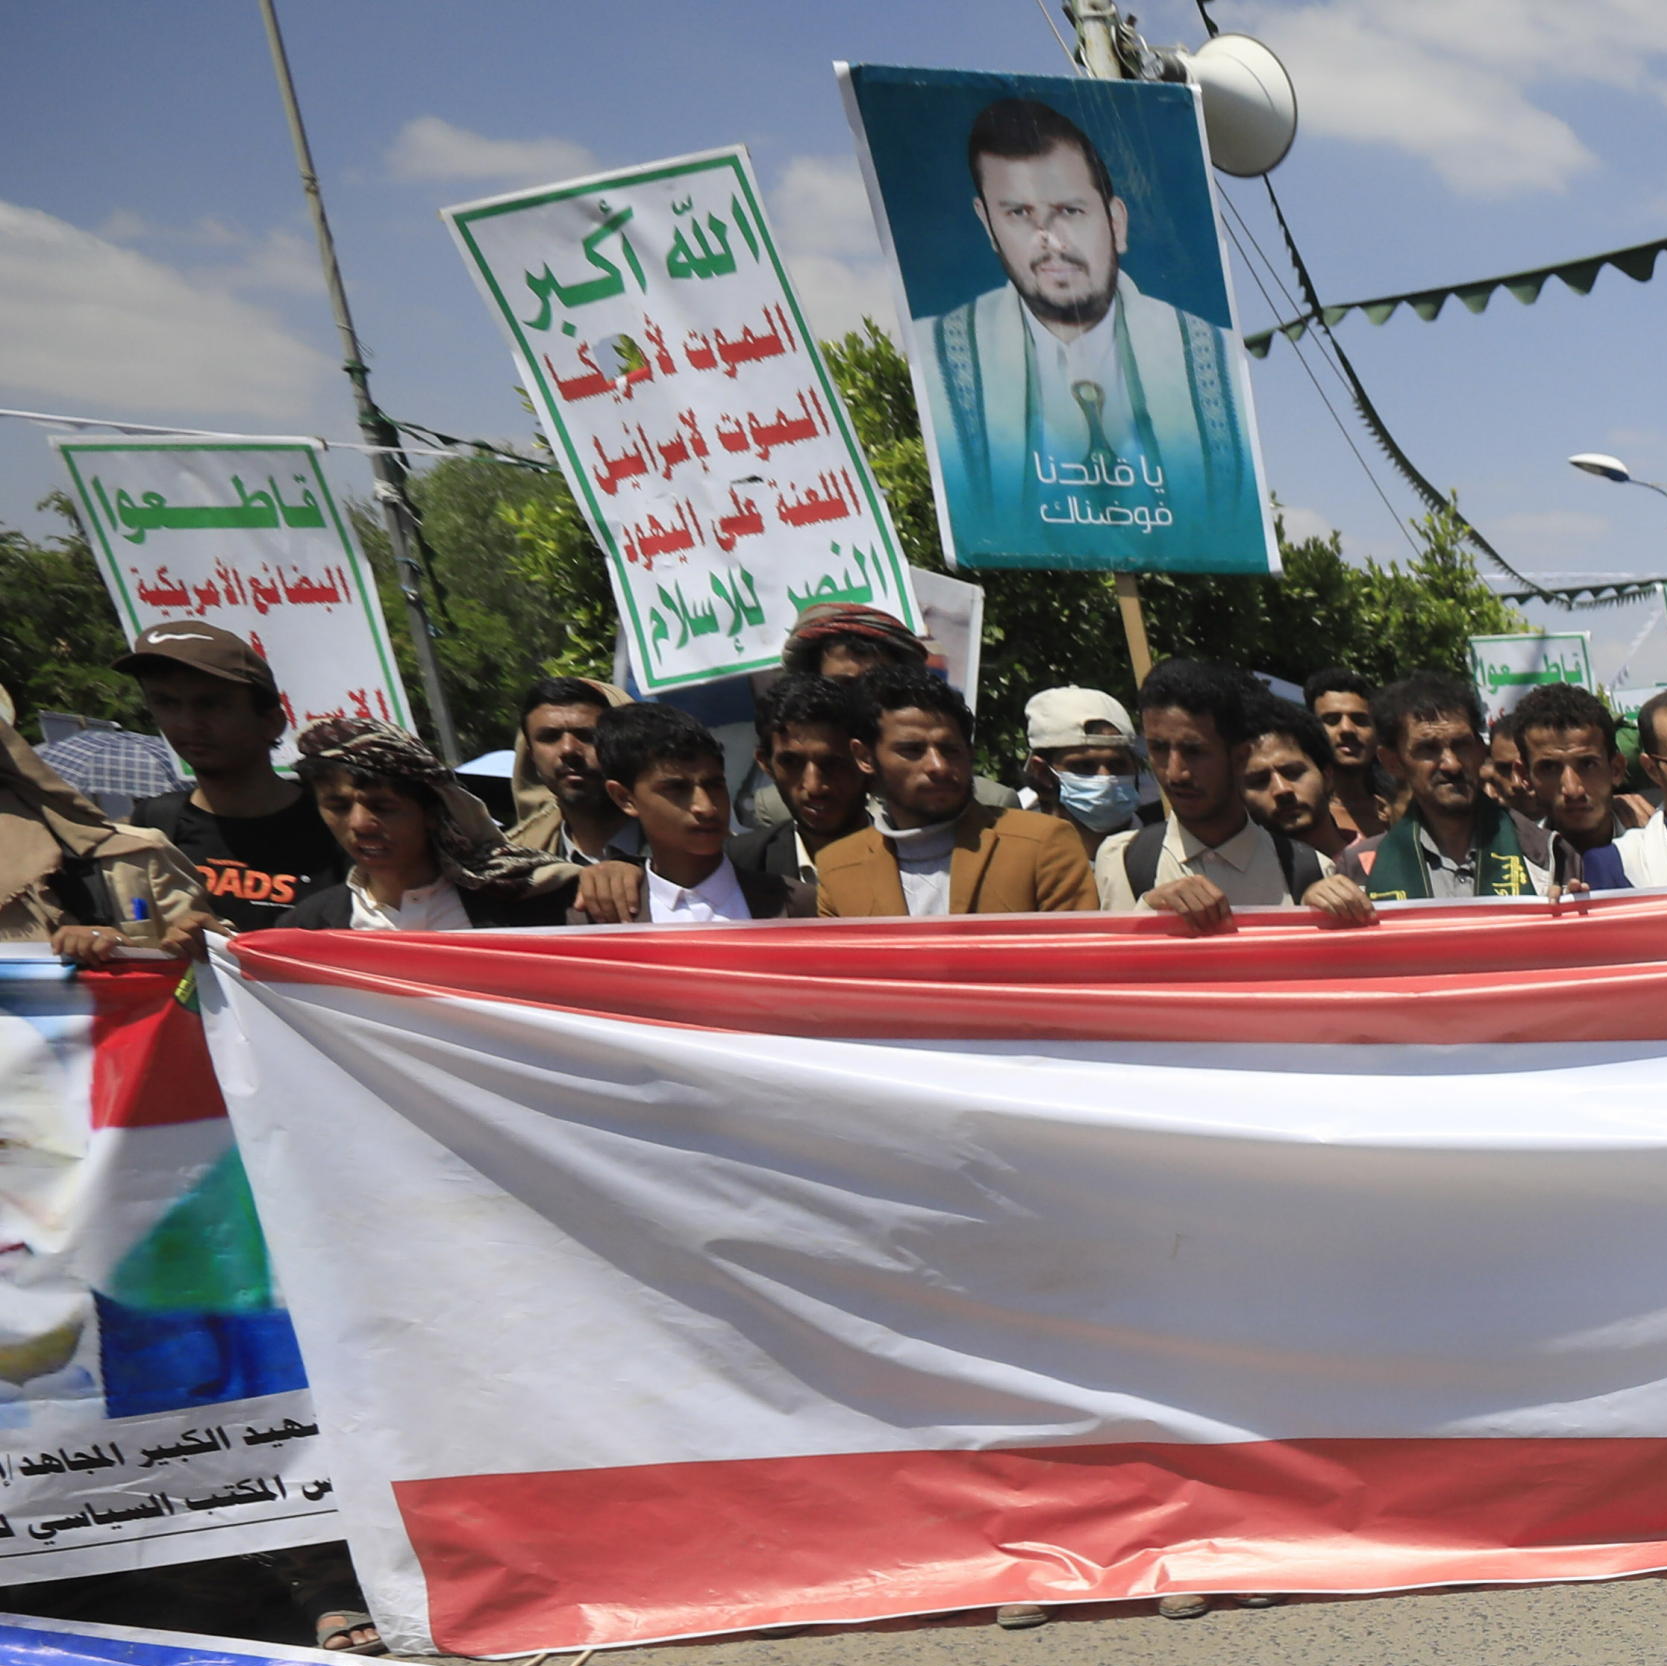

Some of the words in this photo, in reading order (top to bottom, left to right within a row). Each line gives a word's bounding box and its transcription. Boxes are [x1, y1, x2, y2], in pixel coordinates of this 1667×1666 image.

[522, 199, 648, 338] أكبر
[683, 302, 798, 380] الموت
[715, 385, 830, 461] الموت
[768, 466, 863, 528] اللعنة
[1033, 451, 1135, 487] قائدنا
[1140, 454, 1164, 495] يا
[91, 474, 328, 545] قاطعوا
[621, 497, 706, 571] اليهود
[711, 487, 765, 552] على
[1040, 496, 1174, 534] فوضناك
[130, 557, 247, 616] الأمريكية
[246, 562, 352, 616] البضائع
[1477, 653, 1582, 694] قاطعوا
[18, 1441, 126, 1477] المجاهد
[137, 1425, 232, 1469] الكبير
[28, 1491, 175, 1547] السياسي
[184, 1474, 287, 1515] المكتب
